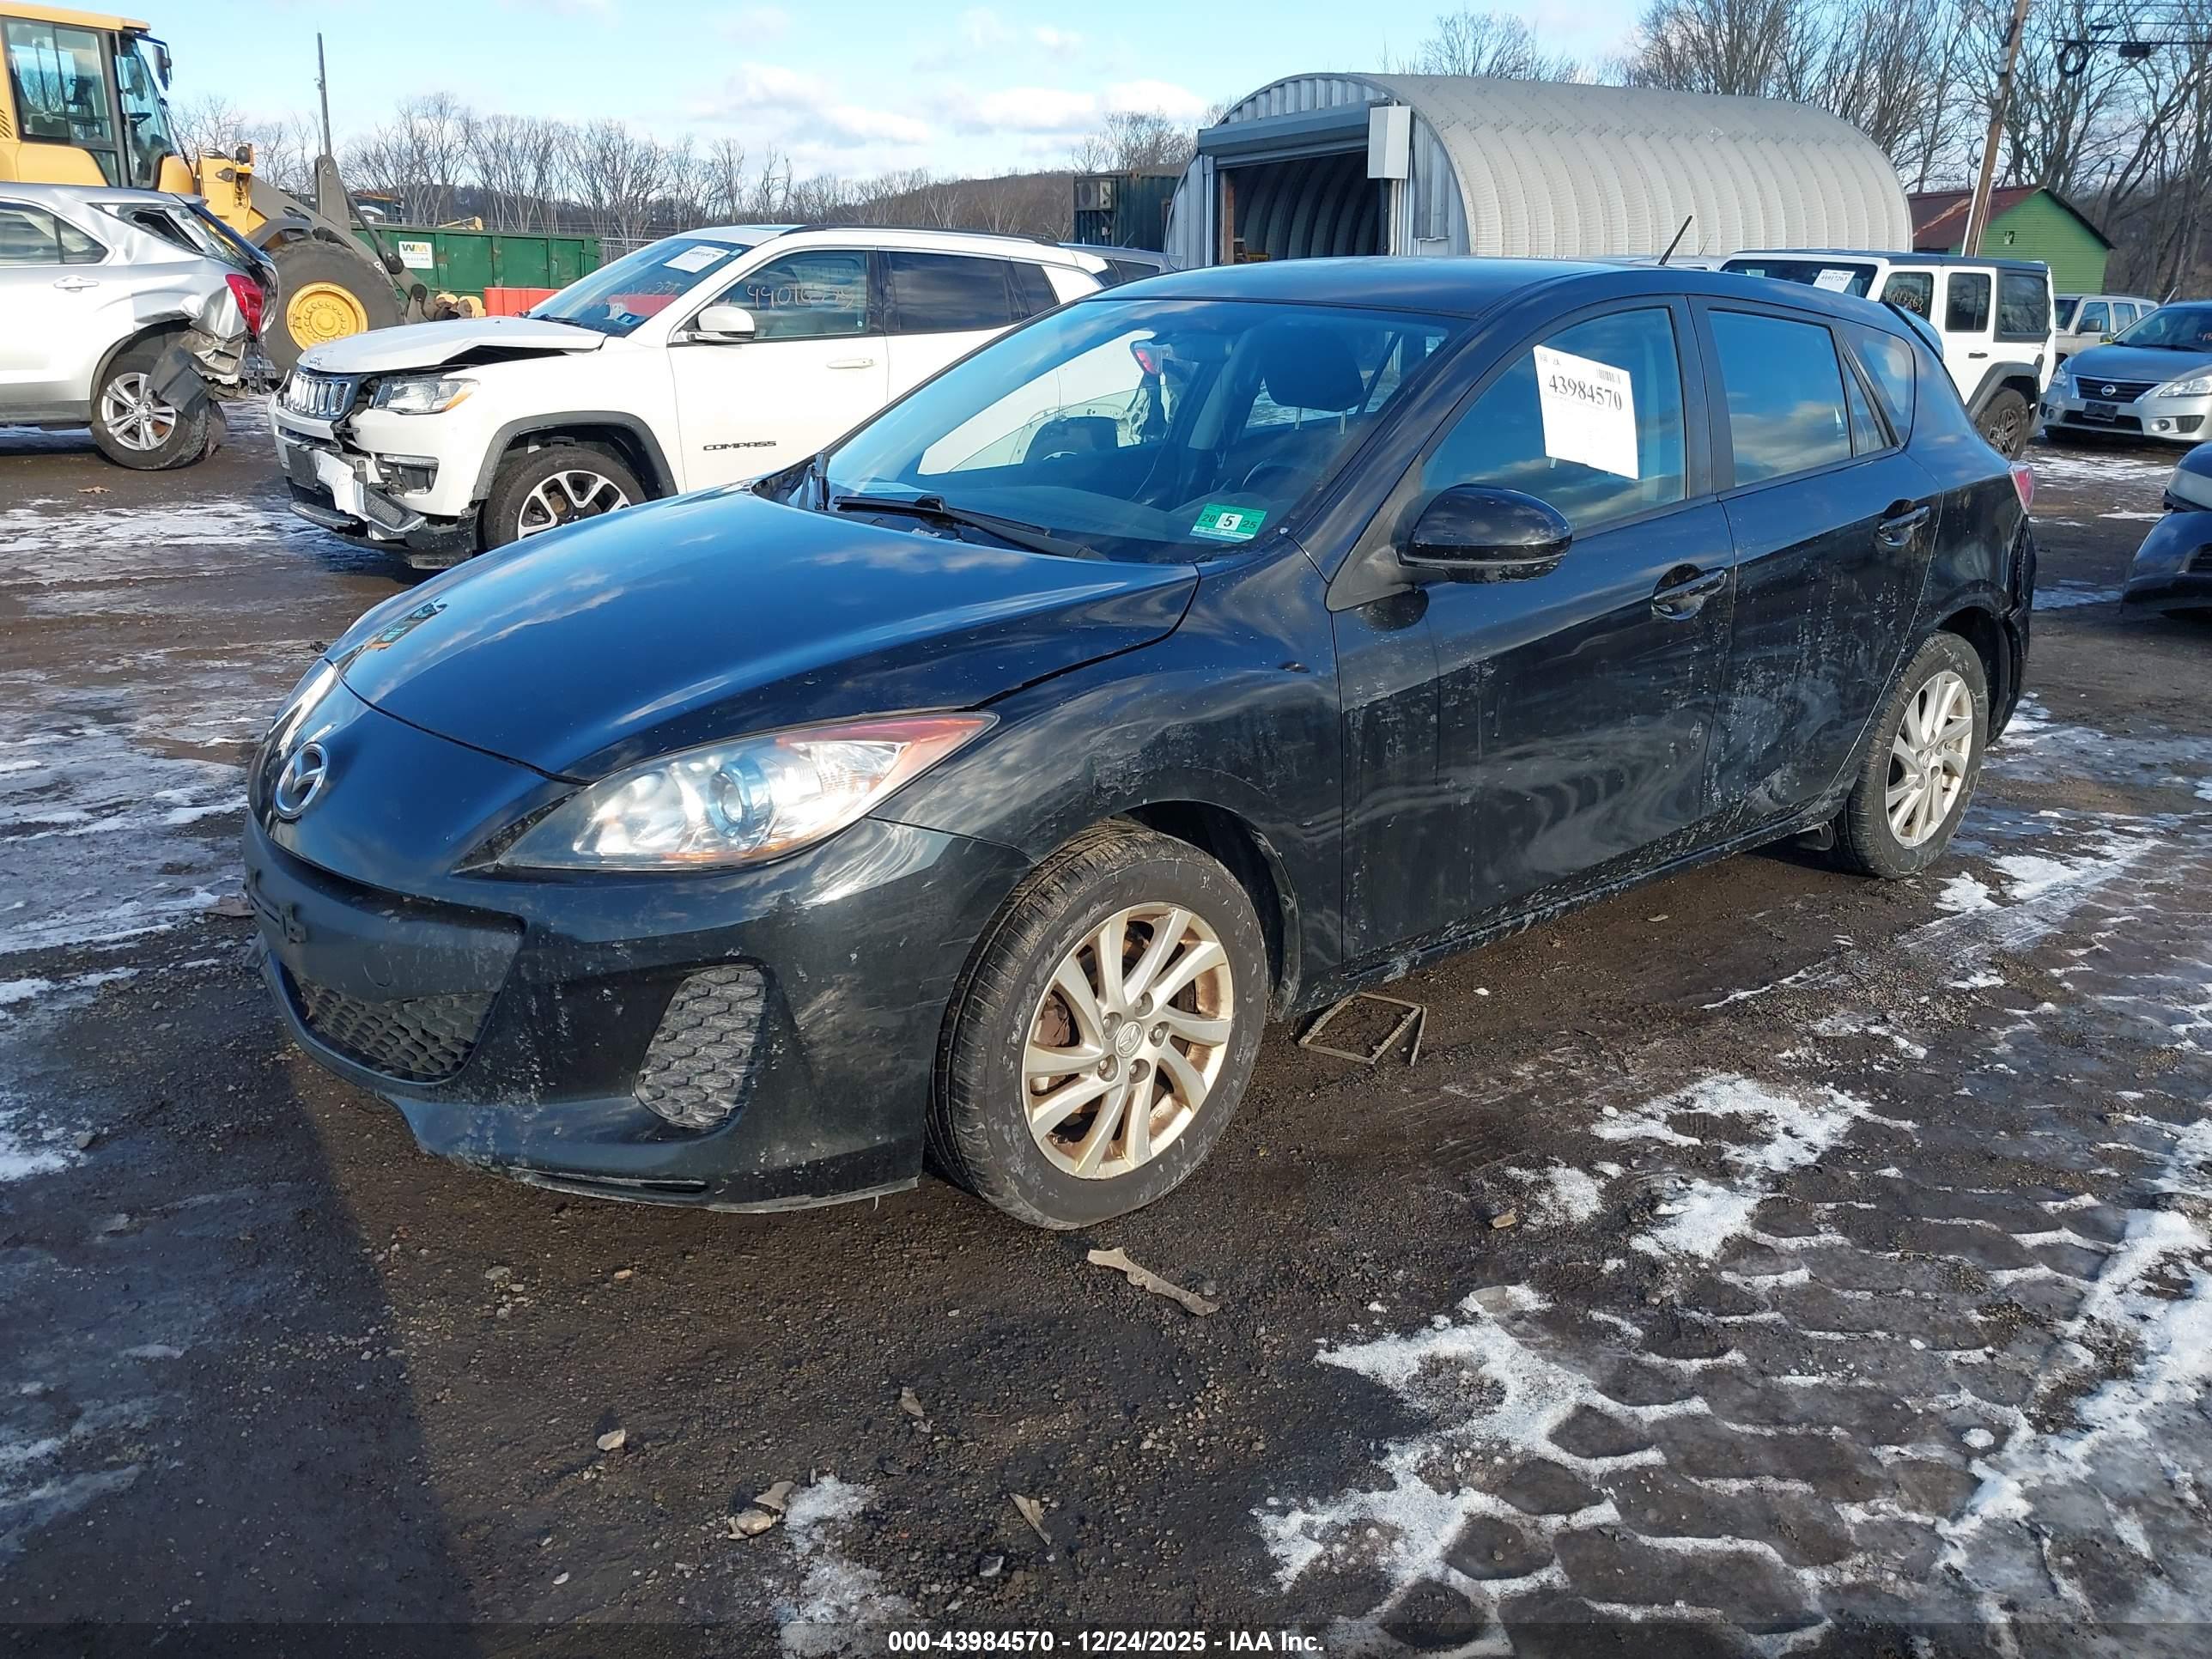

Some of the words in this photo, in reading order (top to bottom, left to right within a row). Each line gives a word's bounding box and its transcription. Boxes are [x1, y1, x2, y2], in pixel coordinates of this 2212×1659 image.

[401, 243, 428, 252] WM
[1548, 374, 1623, 411] 43984570
[702, 441, 777, 451] COMPASS
[1201, 514, 1217, 523] 20
[1223, 515, 1236, 527] 5
[1242, 520, 1258, 529] 25
